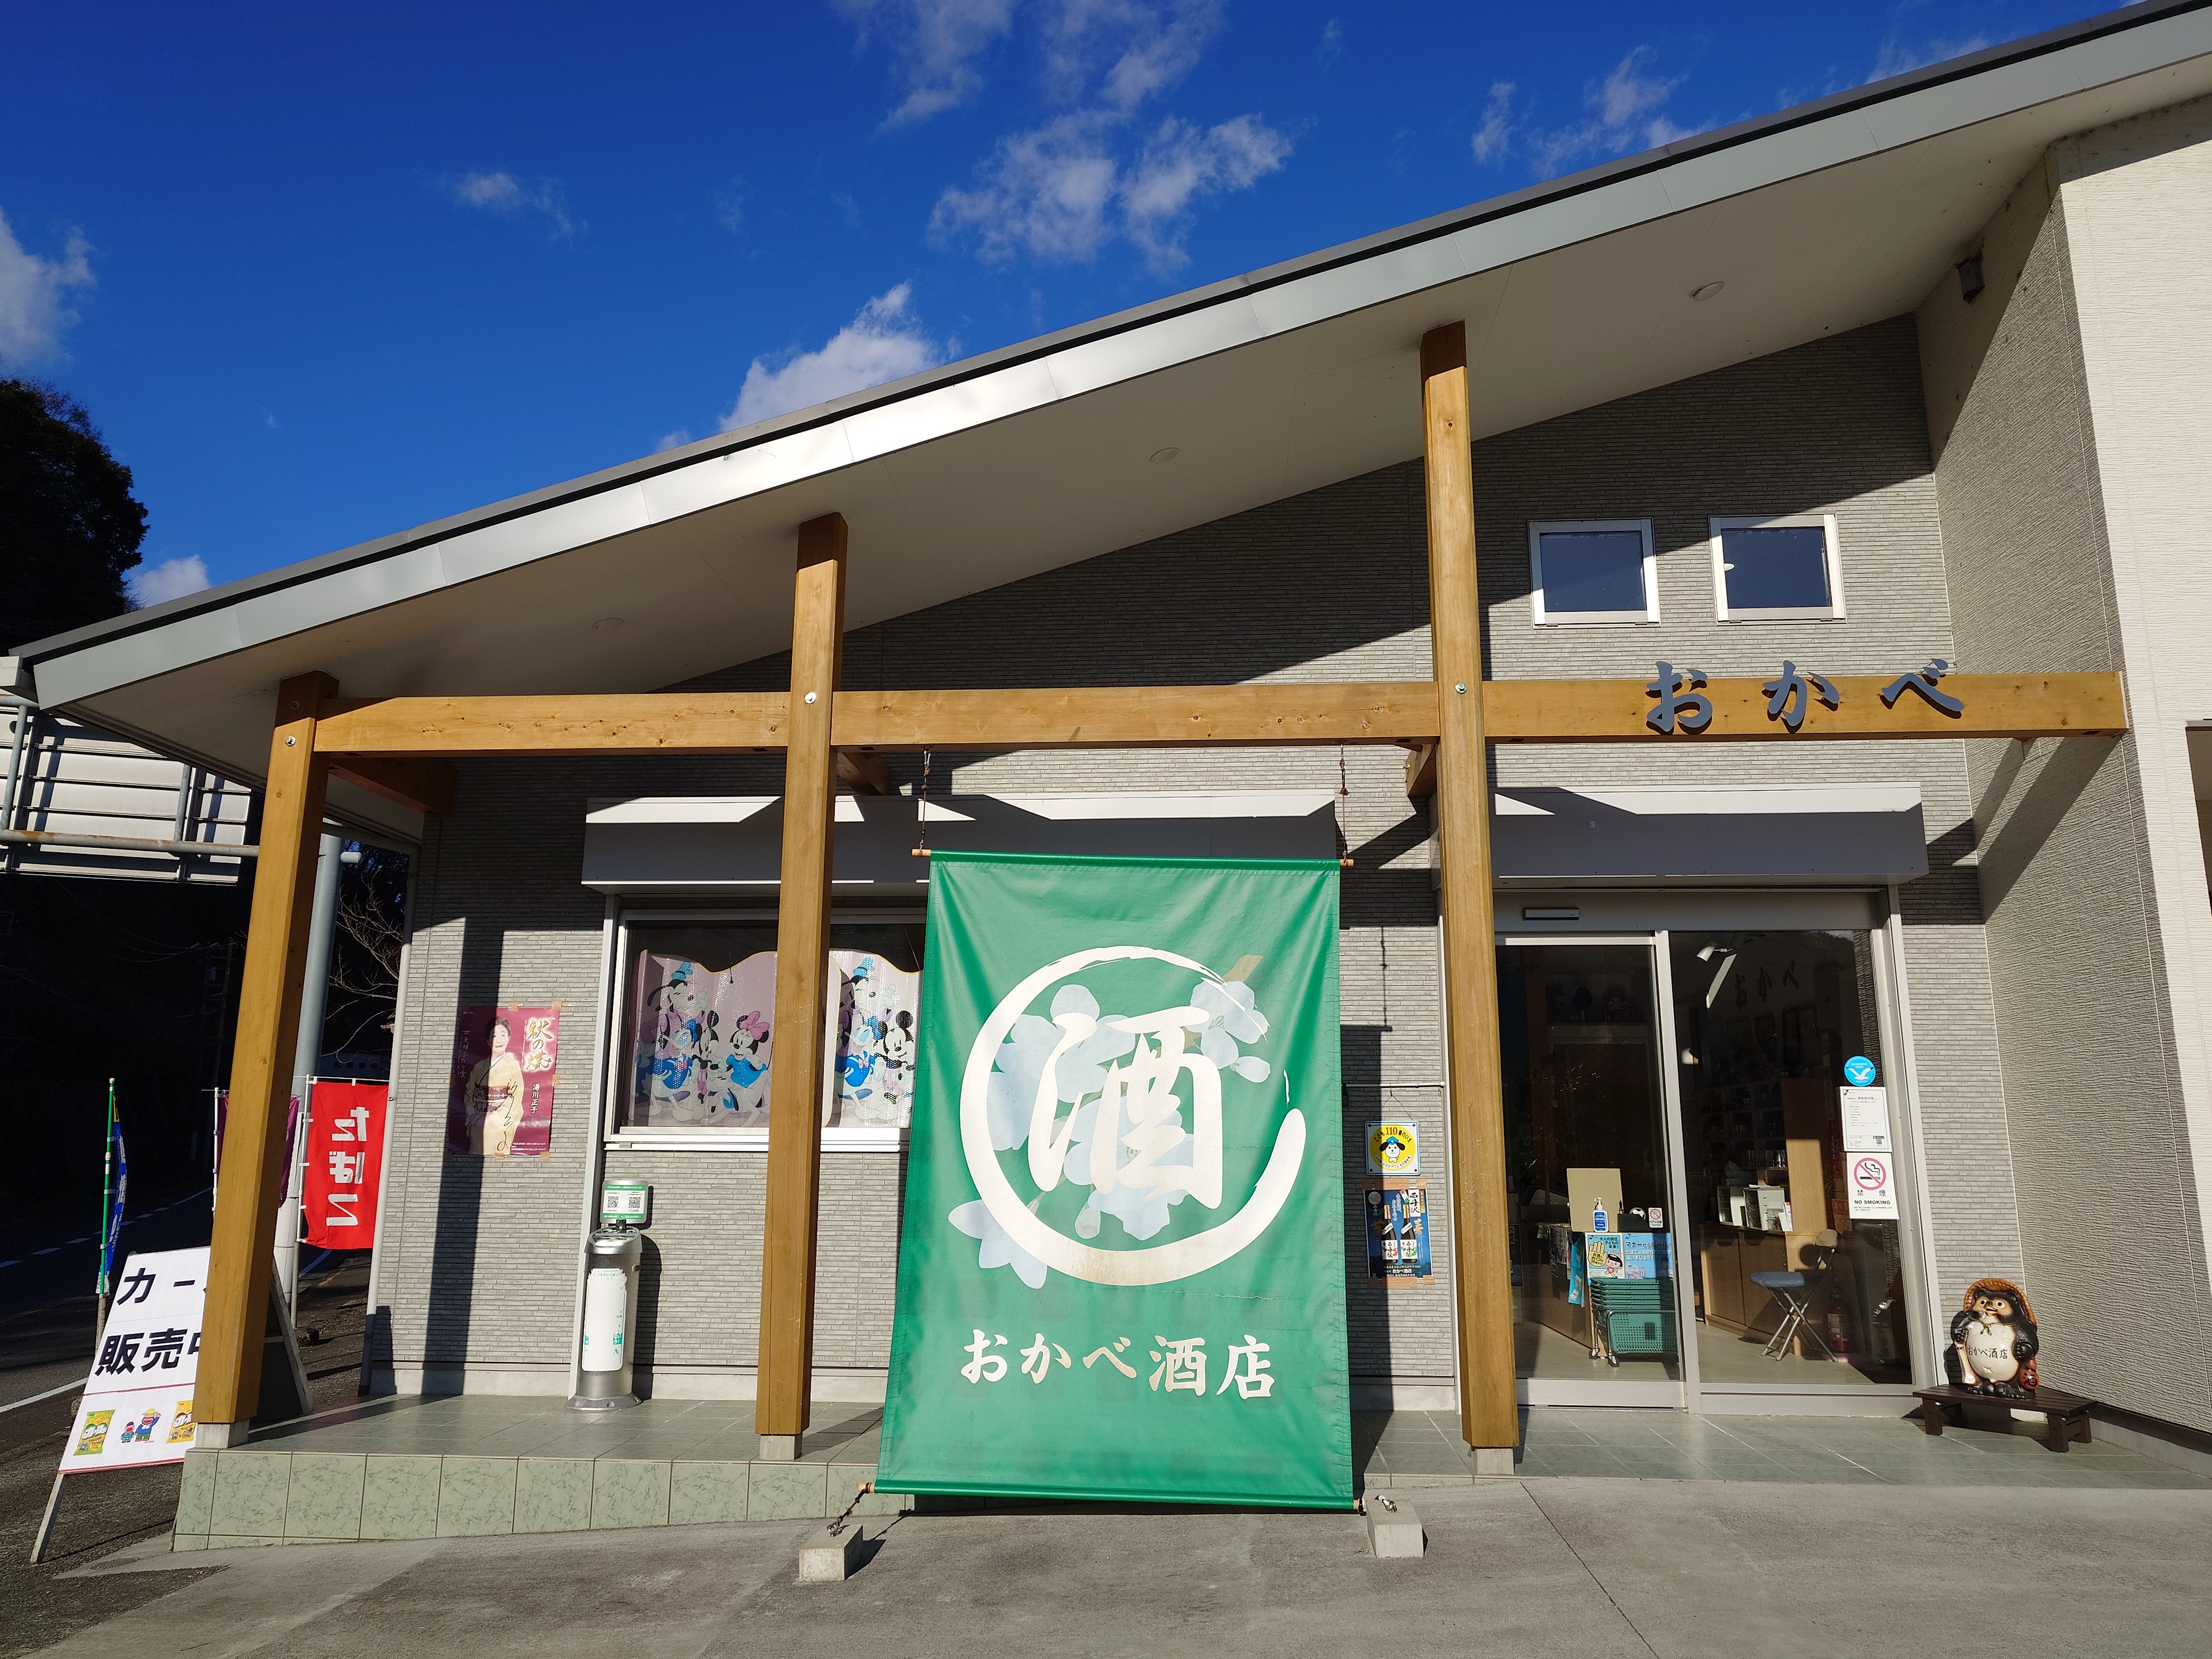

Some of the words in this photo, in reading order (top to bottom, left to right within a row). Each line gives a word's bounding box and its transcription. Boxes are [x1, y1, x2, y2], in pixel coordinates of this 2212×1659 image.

[1646, 658, 1964, 733] おかべ
[530, 1083, 540, 1114] 湯川正子
[1028, 1006, 1223, 1209] 酒
[1410, 1192, 1420, 1214] 西丹沢
[117, 1267, 206, 1306] カー
[960, 1329, 1276, 1400] おかべ酒店
[1968, 1345, 2008, 1359] おかべ酒店
